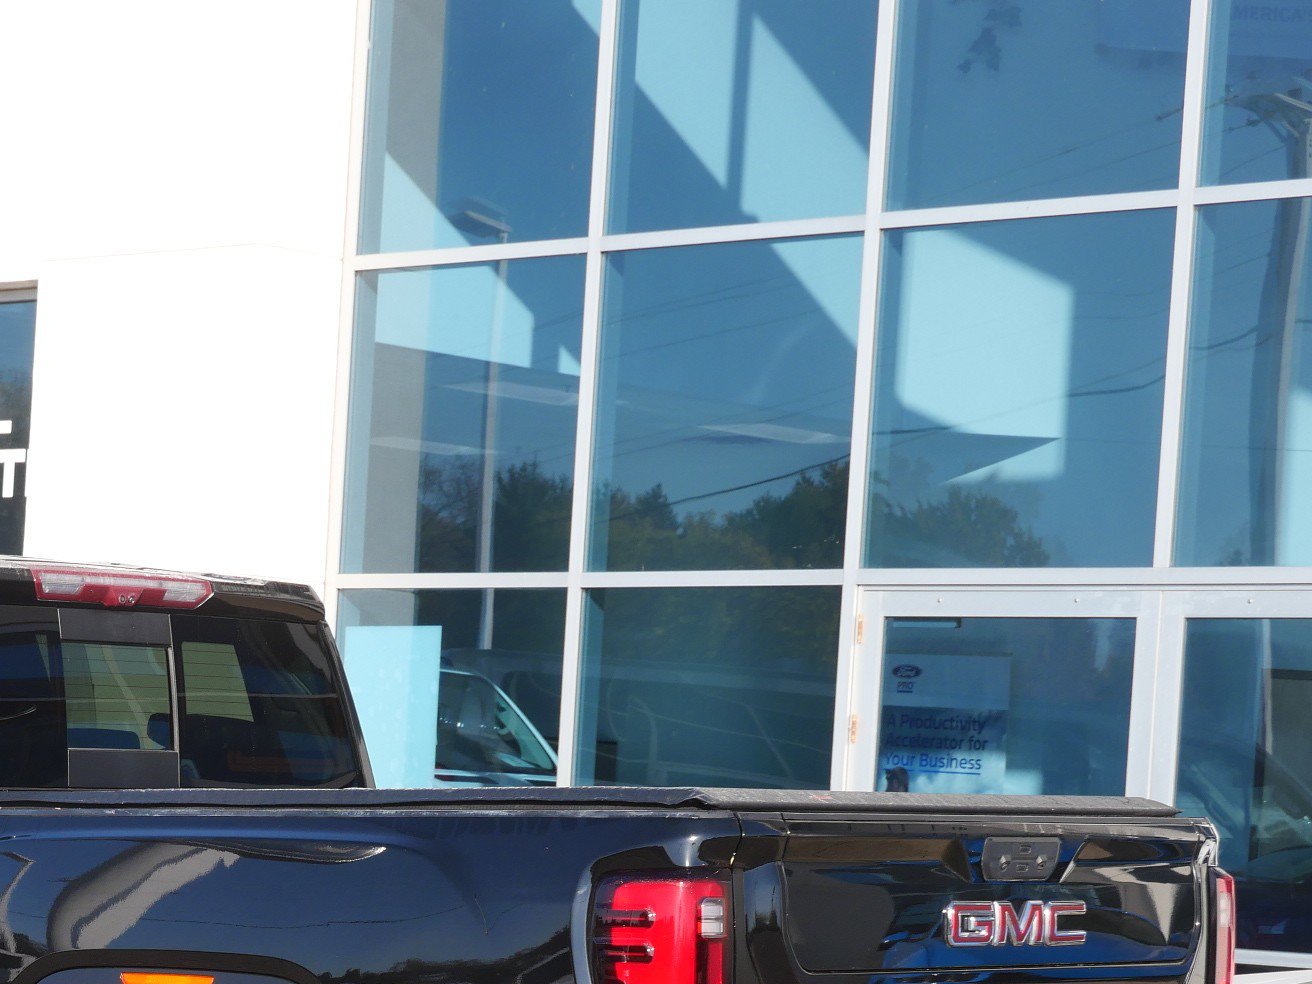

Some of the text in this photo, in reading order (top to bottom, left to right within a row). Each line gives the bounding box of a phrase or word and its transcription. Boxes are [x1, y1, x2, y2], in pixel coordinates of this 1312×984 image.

[899, 714, 986, 734] Productivity
[887, 732, 989, 750] Accelerator for
[887, 752, 981, 770] Your Business
[944, 900, 1086, 947] GMC
